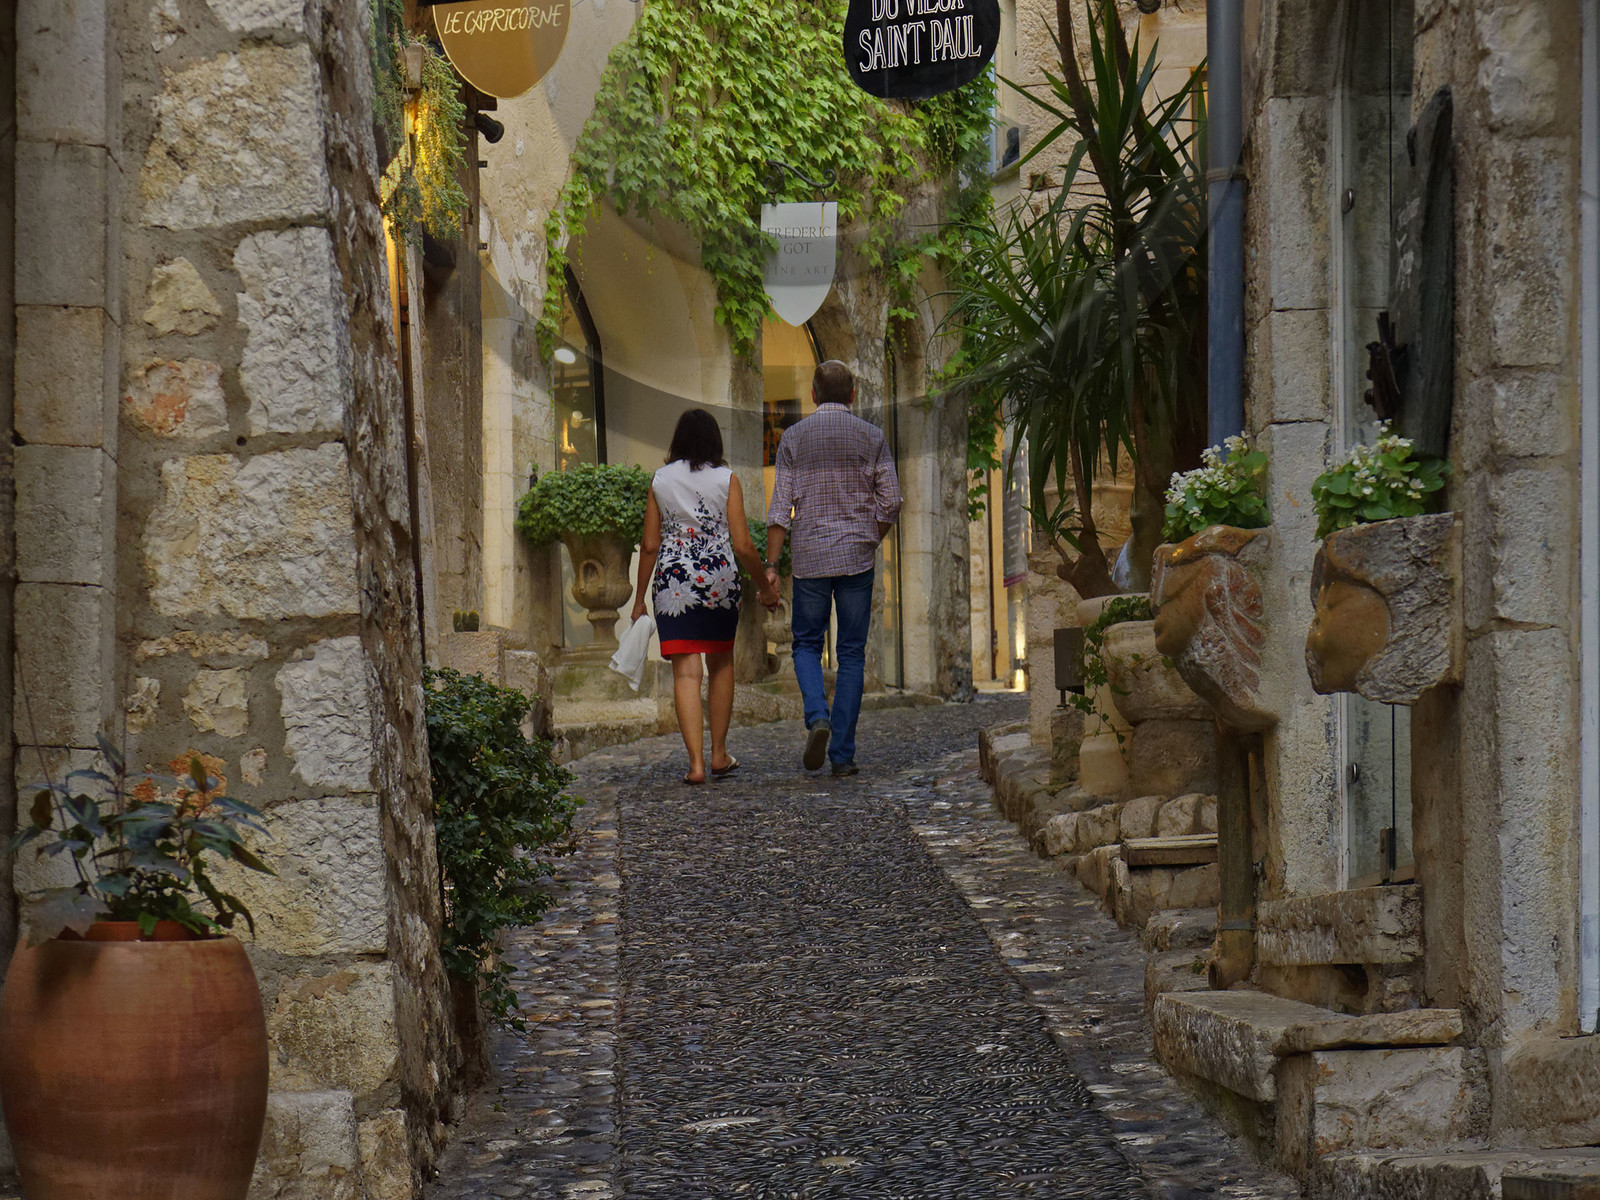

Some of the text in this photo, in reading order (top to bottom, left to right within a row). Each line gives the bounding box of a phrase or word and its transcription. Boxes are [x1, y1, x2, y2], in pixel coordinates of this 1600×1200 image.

[443, 3, 565, 35] LE CAPRICORNE
[859, 15, 982, 72] SAINT PAUL
[783, 242, 812, 255] GOT
[804, 265, 829, 275] ART
